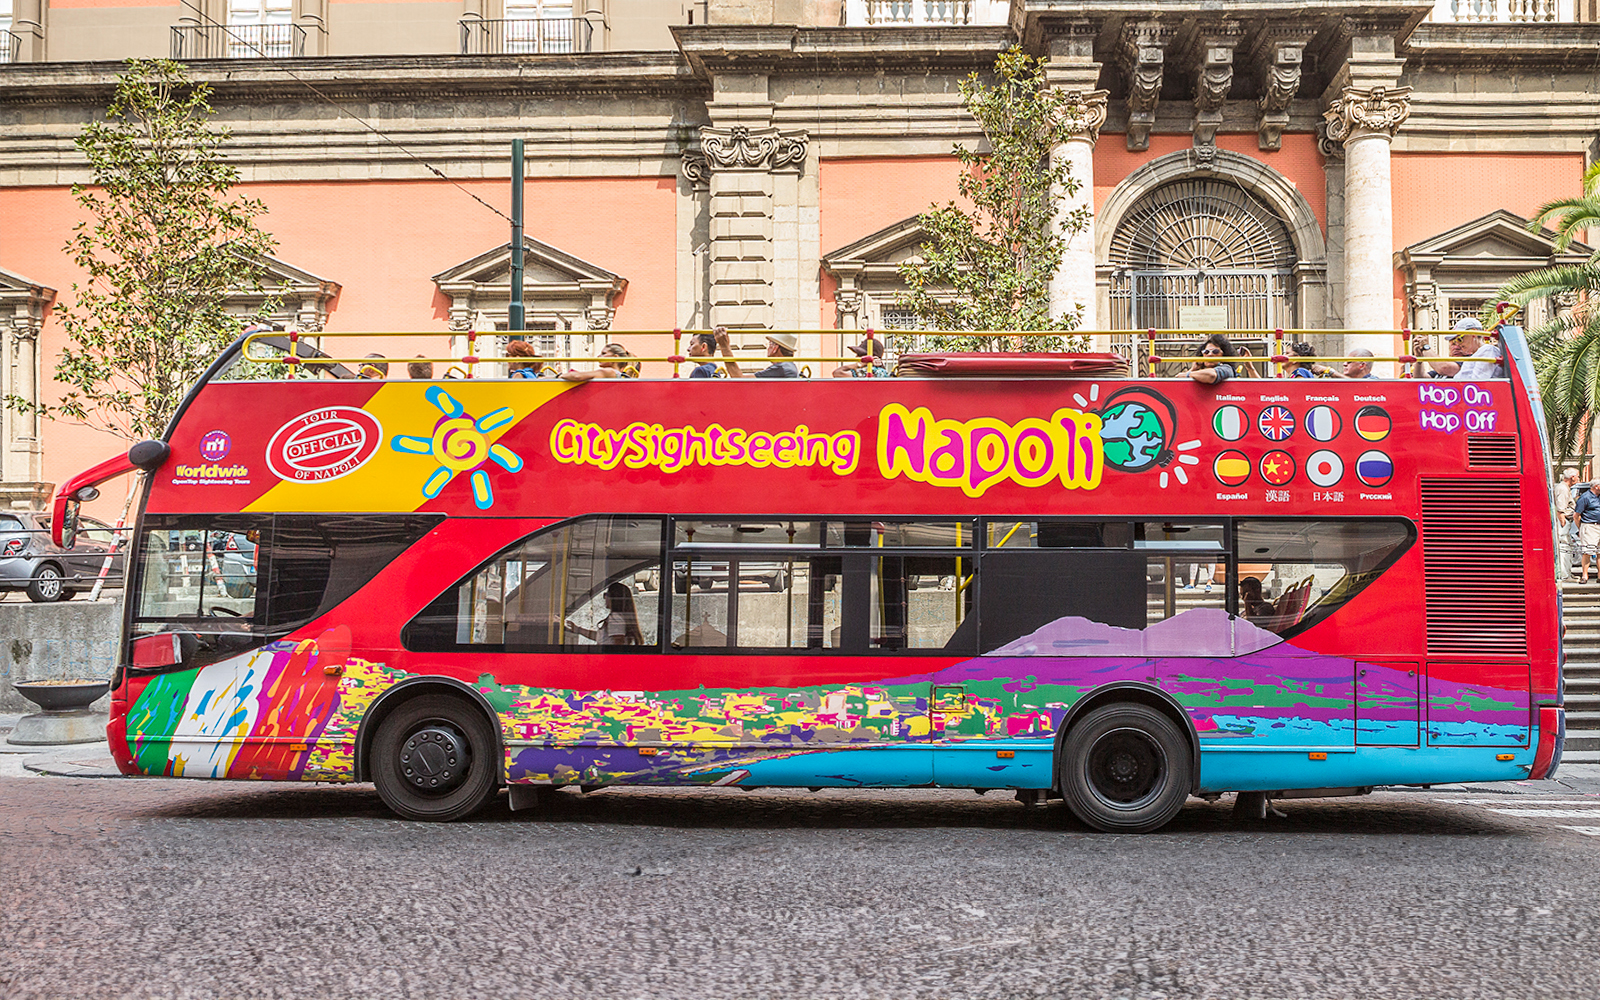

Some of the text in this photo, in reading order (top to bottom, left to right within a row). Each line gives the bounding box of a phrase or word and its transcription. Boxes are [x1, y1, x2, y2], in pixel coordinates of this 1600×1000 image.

[1215, 394, 1246, 402] Italiano
[1260, 395, 1290, 403] English
[1305, 395, 1340, 403] Français
[1419, 384, 1491, 407] Hop On
[301, 410, 339, 426] TOUR
[1420, 410, 1496, 433] Hop Off
[288, 431, 361, 458] OFFICIAL
[880, 405, 1102, 496] Napoli
[175, 463, 249, 478] Worldwide
[294, 456, 360, 480] OF NAPOLI
[1216, 492, 1248, 501] Español
[1265, 489, 1291, 503] 漢語
[1313, 491, 1344, 503] 日本語
